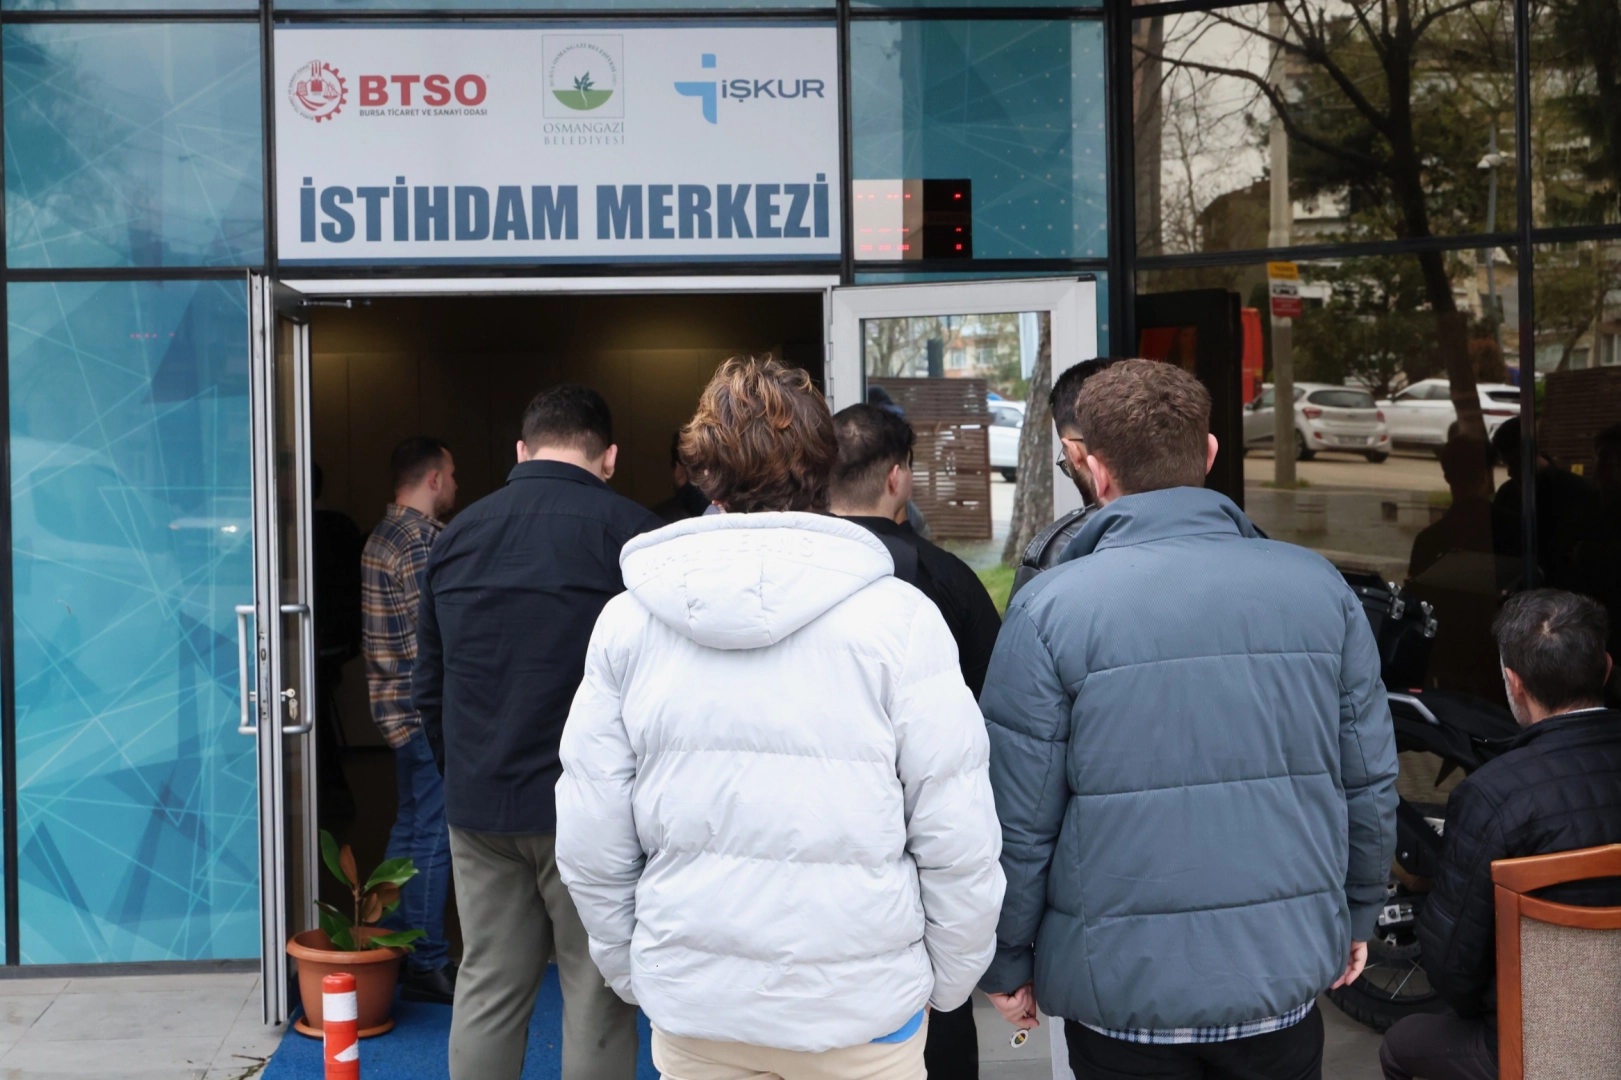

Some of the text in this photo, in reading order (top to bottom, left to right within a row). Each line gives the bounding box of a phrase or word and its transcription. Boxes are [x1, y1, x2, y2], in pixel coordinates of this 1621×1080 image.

[359, 74, 487, 107] BTSO
[359, 107, 488, 117] BURSA TİCARET VE SANAYİ ODASI
[543, 121, 625, 134] OSMANGAZİ
[544, 135, 625, 145] BELEDİYESİ
[300, 172, 830, 244] İSTİHDAM MERKEZİ
